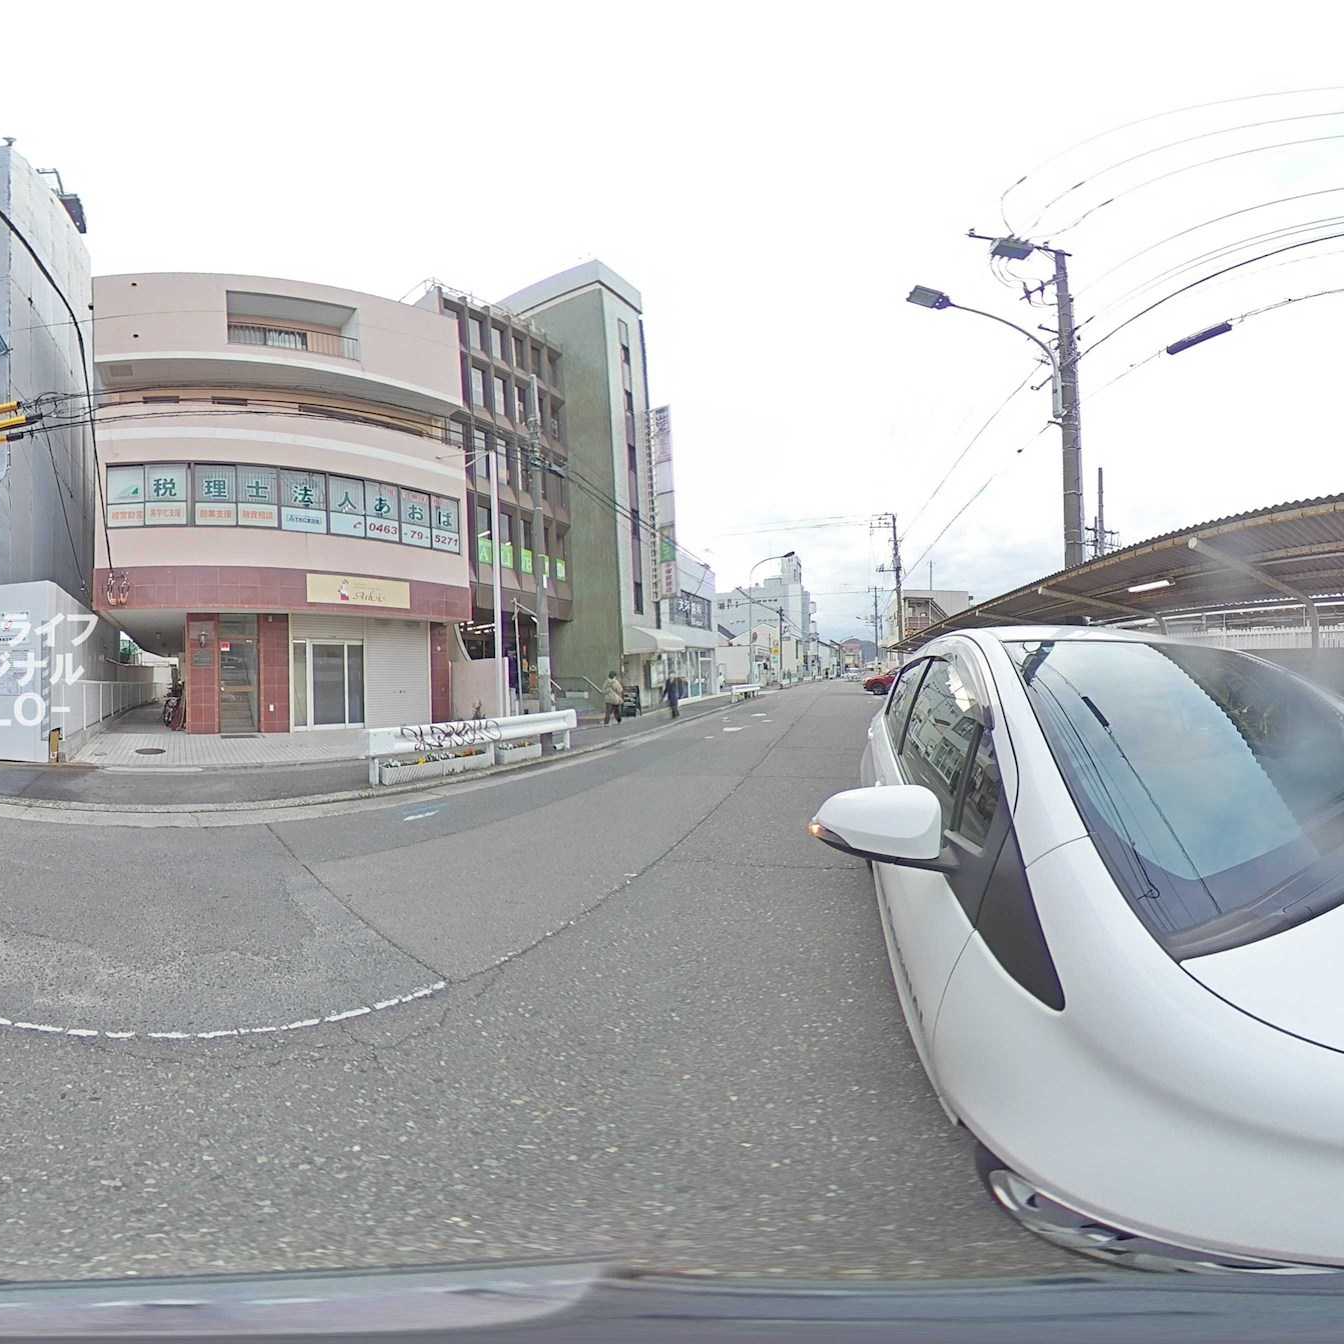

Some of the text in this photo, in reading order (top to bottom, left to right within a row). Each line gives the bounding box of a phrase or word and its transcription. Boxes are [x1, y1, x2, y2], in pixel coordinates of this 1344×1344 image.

[152, 478, 453, 527] 税理士法人あおば
